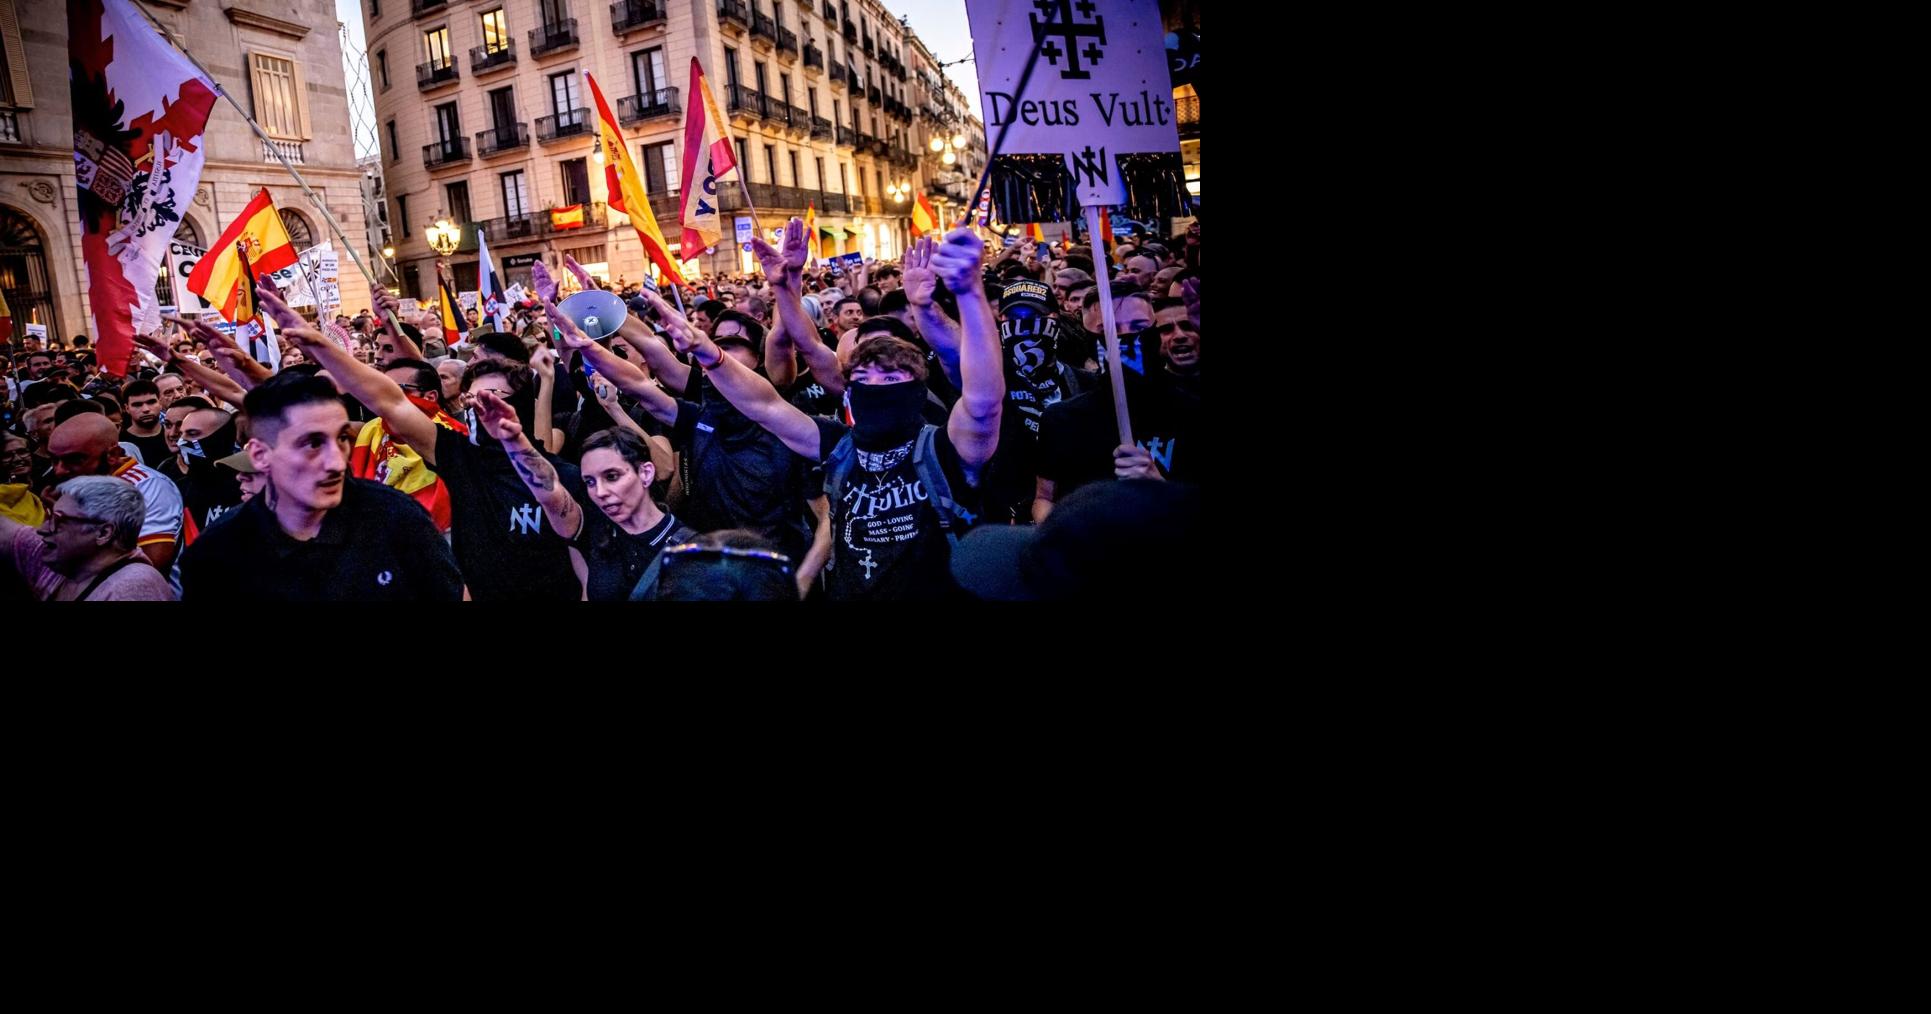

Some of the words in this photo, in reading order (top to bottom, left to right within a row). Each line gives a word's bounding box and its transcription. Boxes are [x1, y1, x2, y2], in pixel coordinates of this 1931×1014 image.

[984, 91, 1080, 127] Deus
[867, 520, 882, 528] GOD
[887, 514, 914, 525] LOVING
